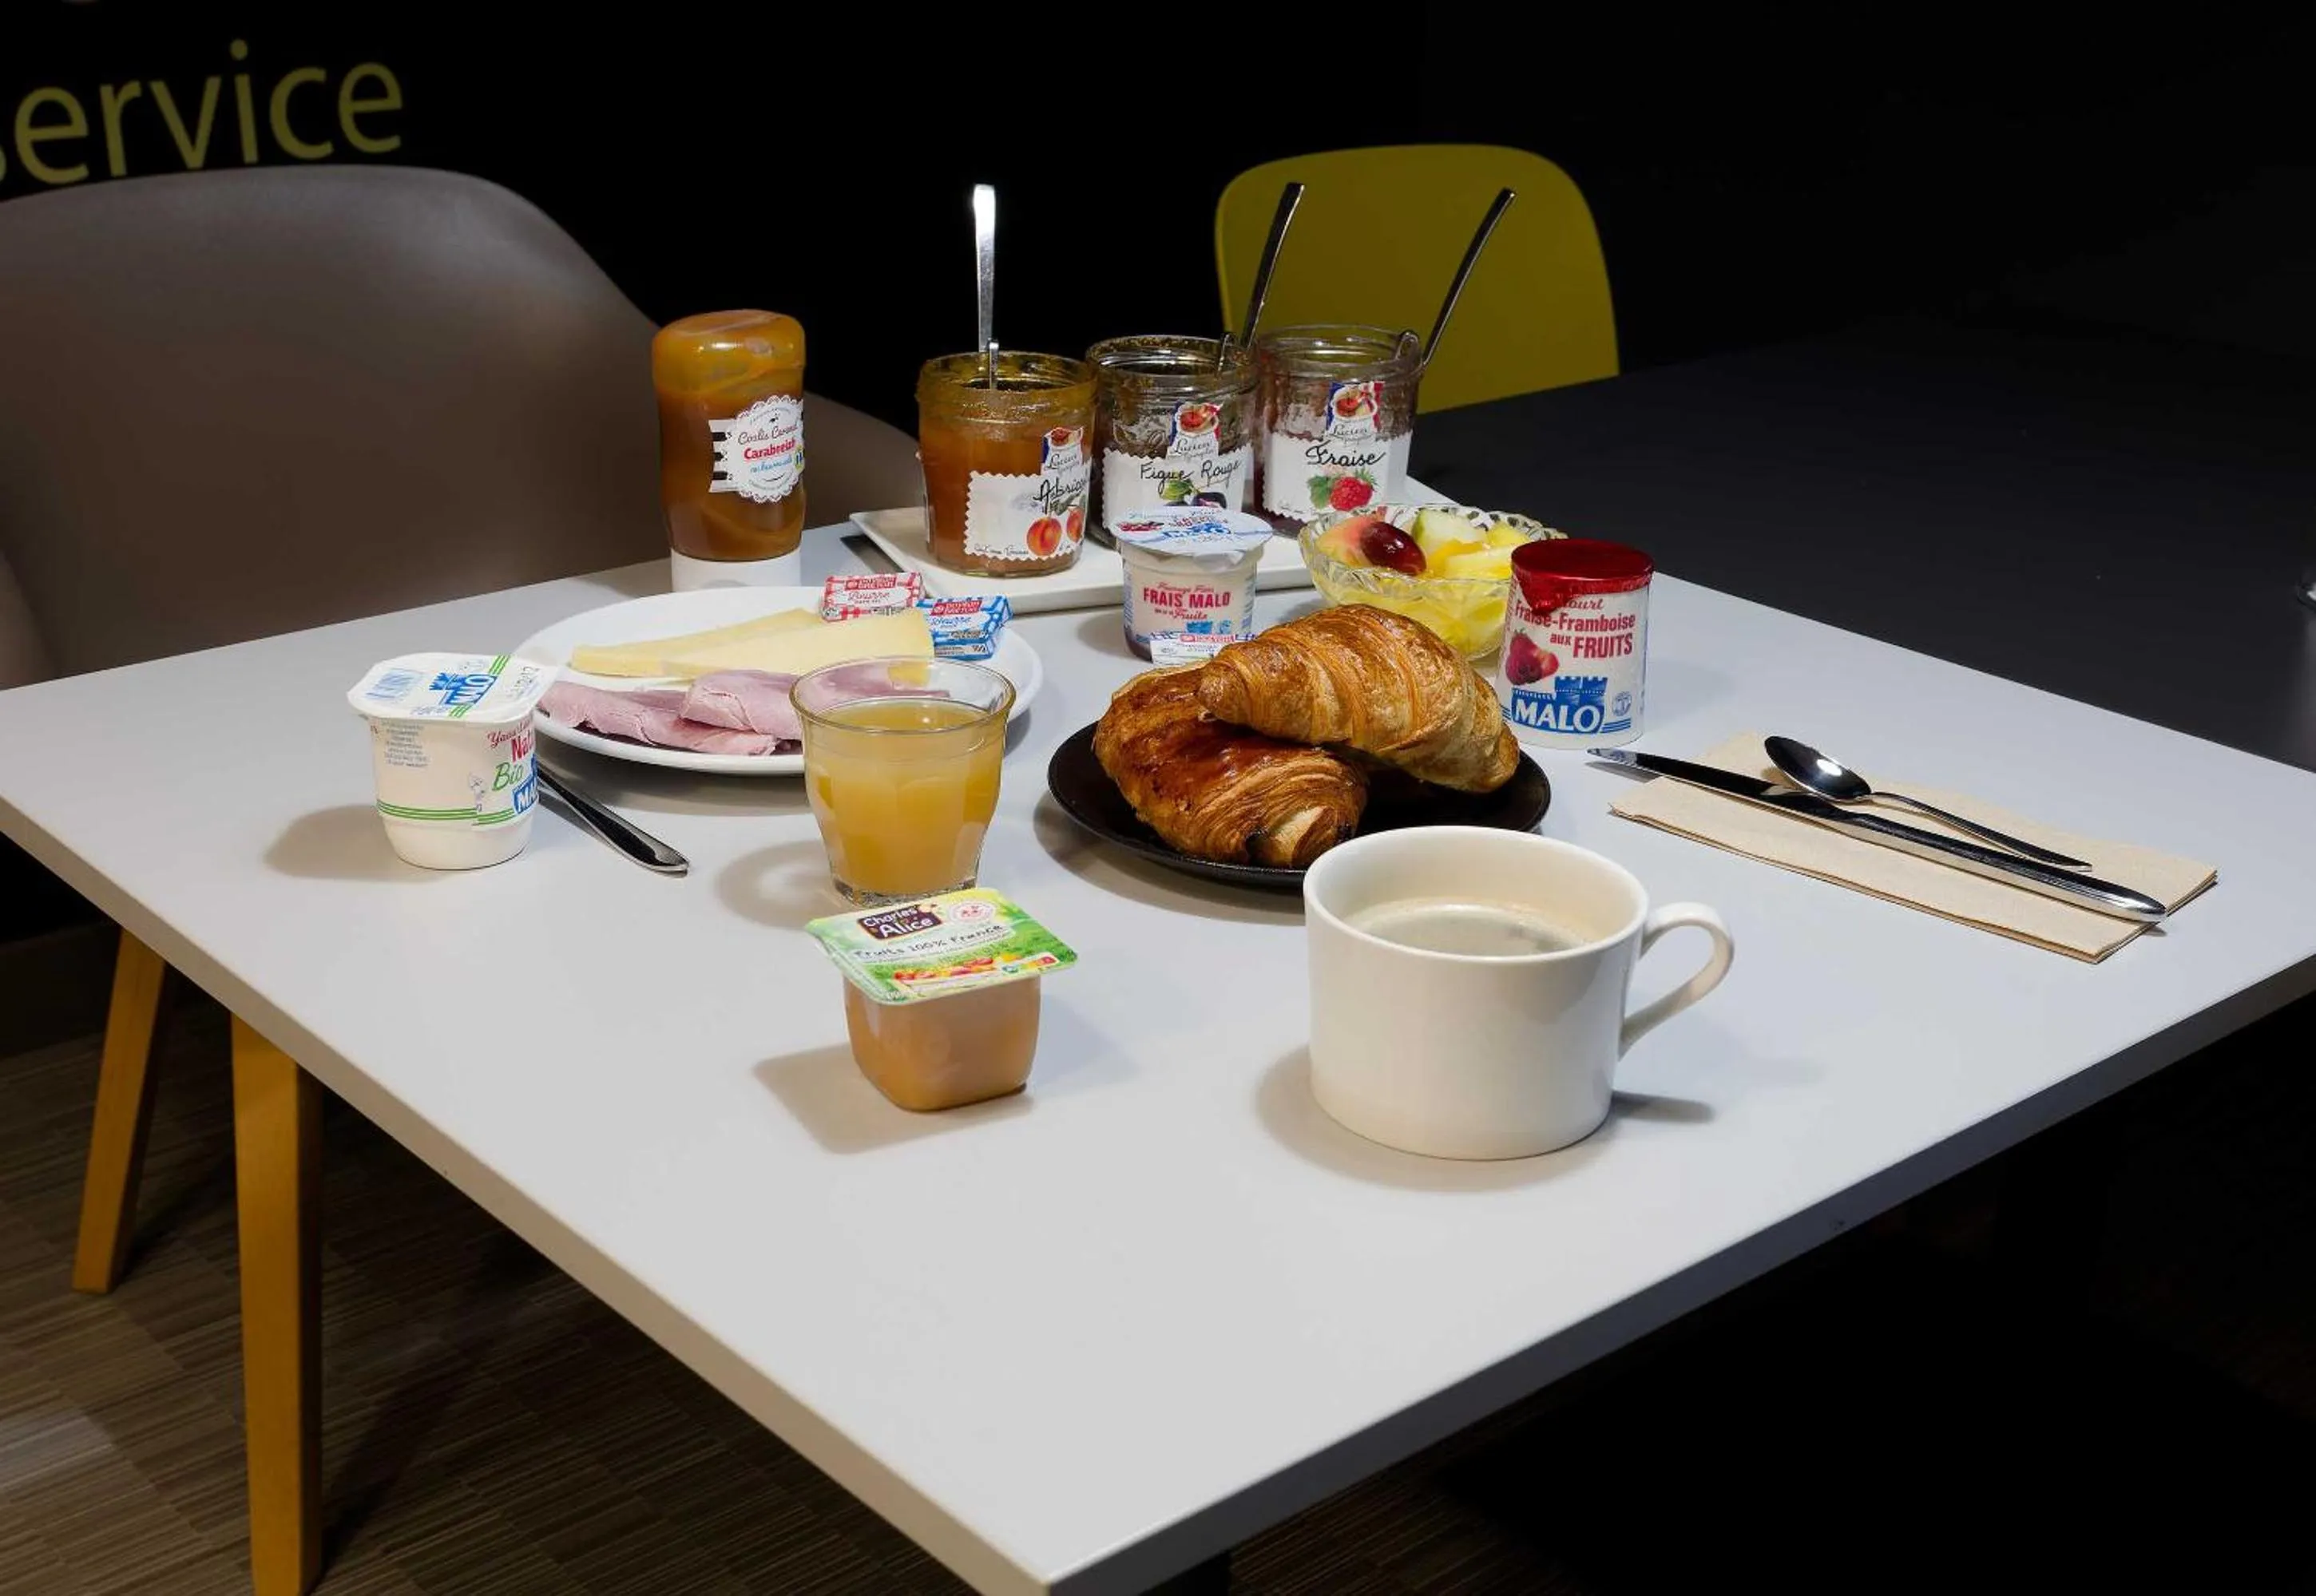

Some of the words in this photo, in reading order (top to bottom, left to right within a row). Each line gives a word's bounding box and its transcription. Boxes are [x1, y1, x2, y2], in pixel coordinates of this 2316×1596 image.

[0, 38, 403, 185] ervice
[1305, 440, 1386, 467] Fraise
[1140, 461, 1196, 495] Figue
[1200, 459, 1240, 489] Rouge
[1143, 587, 1183, 608] FRAIS
[1189, 591, 1231, 609] MALO
[1550, 634, 1572, 646] aux
[1573, 633, 1634, 659] FRUITS
[1514, 698, 1601, 734] MALO
[492, 762, 523, 791] Bio
[863, 909, 918, 929] Charles
[879, 916, 934, 938] Alice
[950, 925, 1003, 944] France
